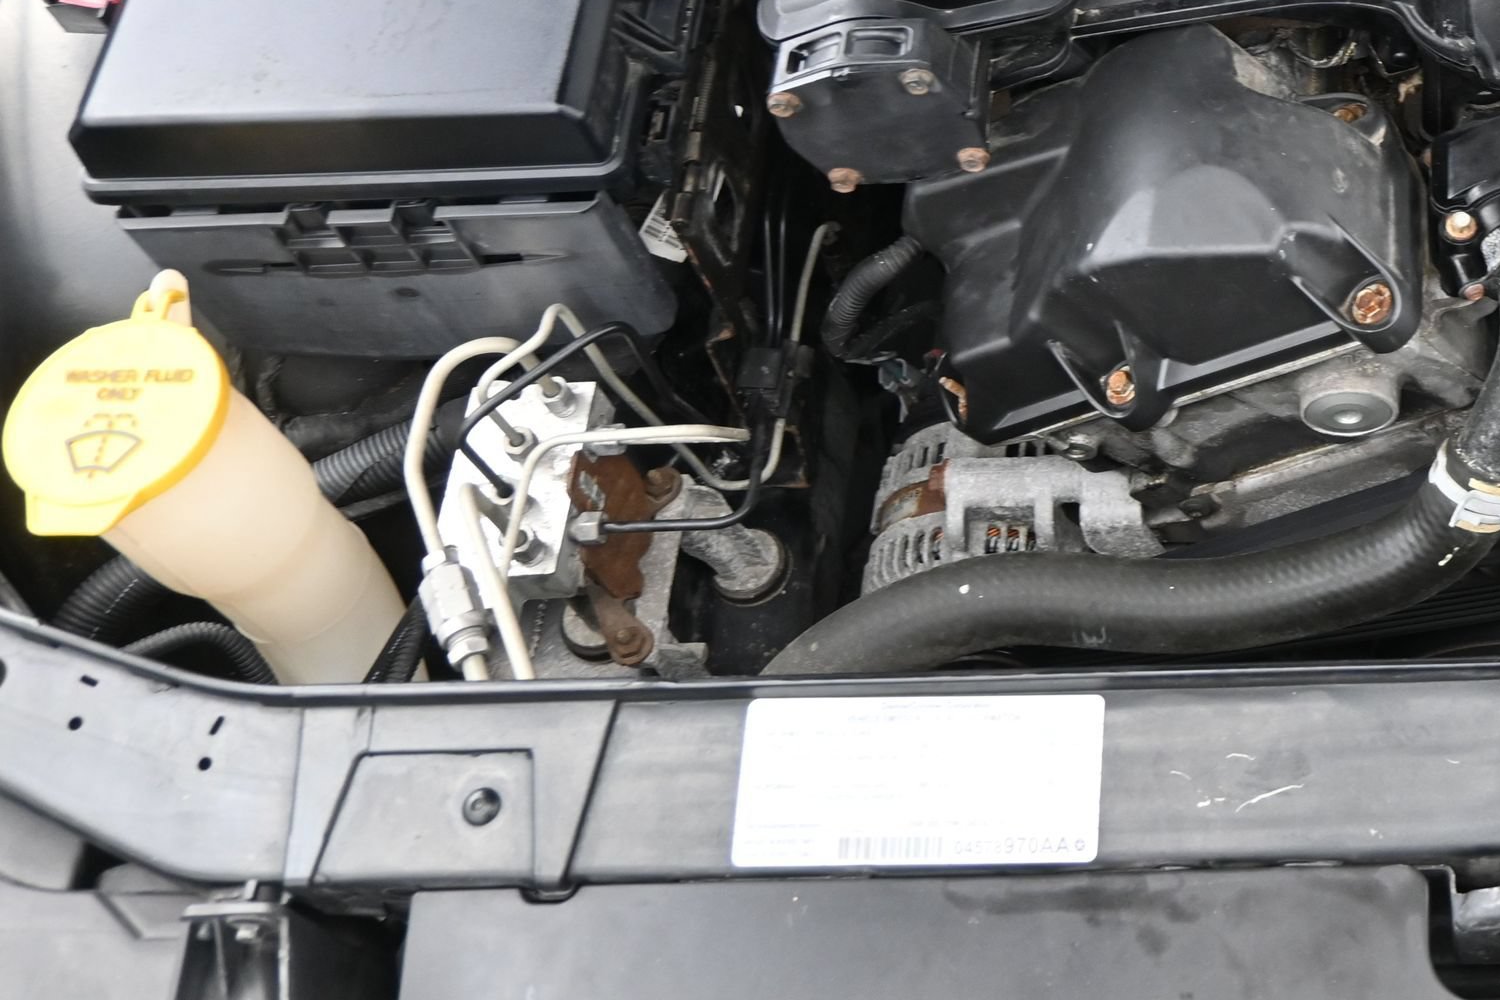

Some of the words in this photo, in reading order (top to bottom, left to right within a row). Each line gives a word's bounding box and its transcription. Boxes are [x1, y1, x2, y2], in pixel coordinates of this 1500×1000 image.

[66, 369, 138, 384] WASHER
[144, 368, 194, 383] FLUID
[96, 387, 142, 401] ONLY
